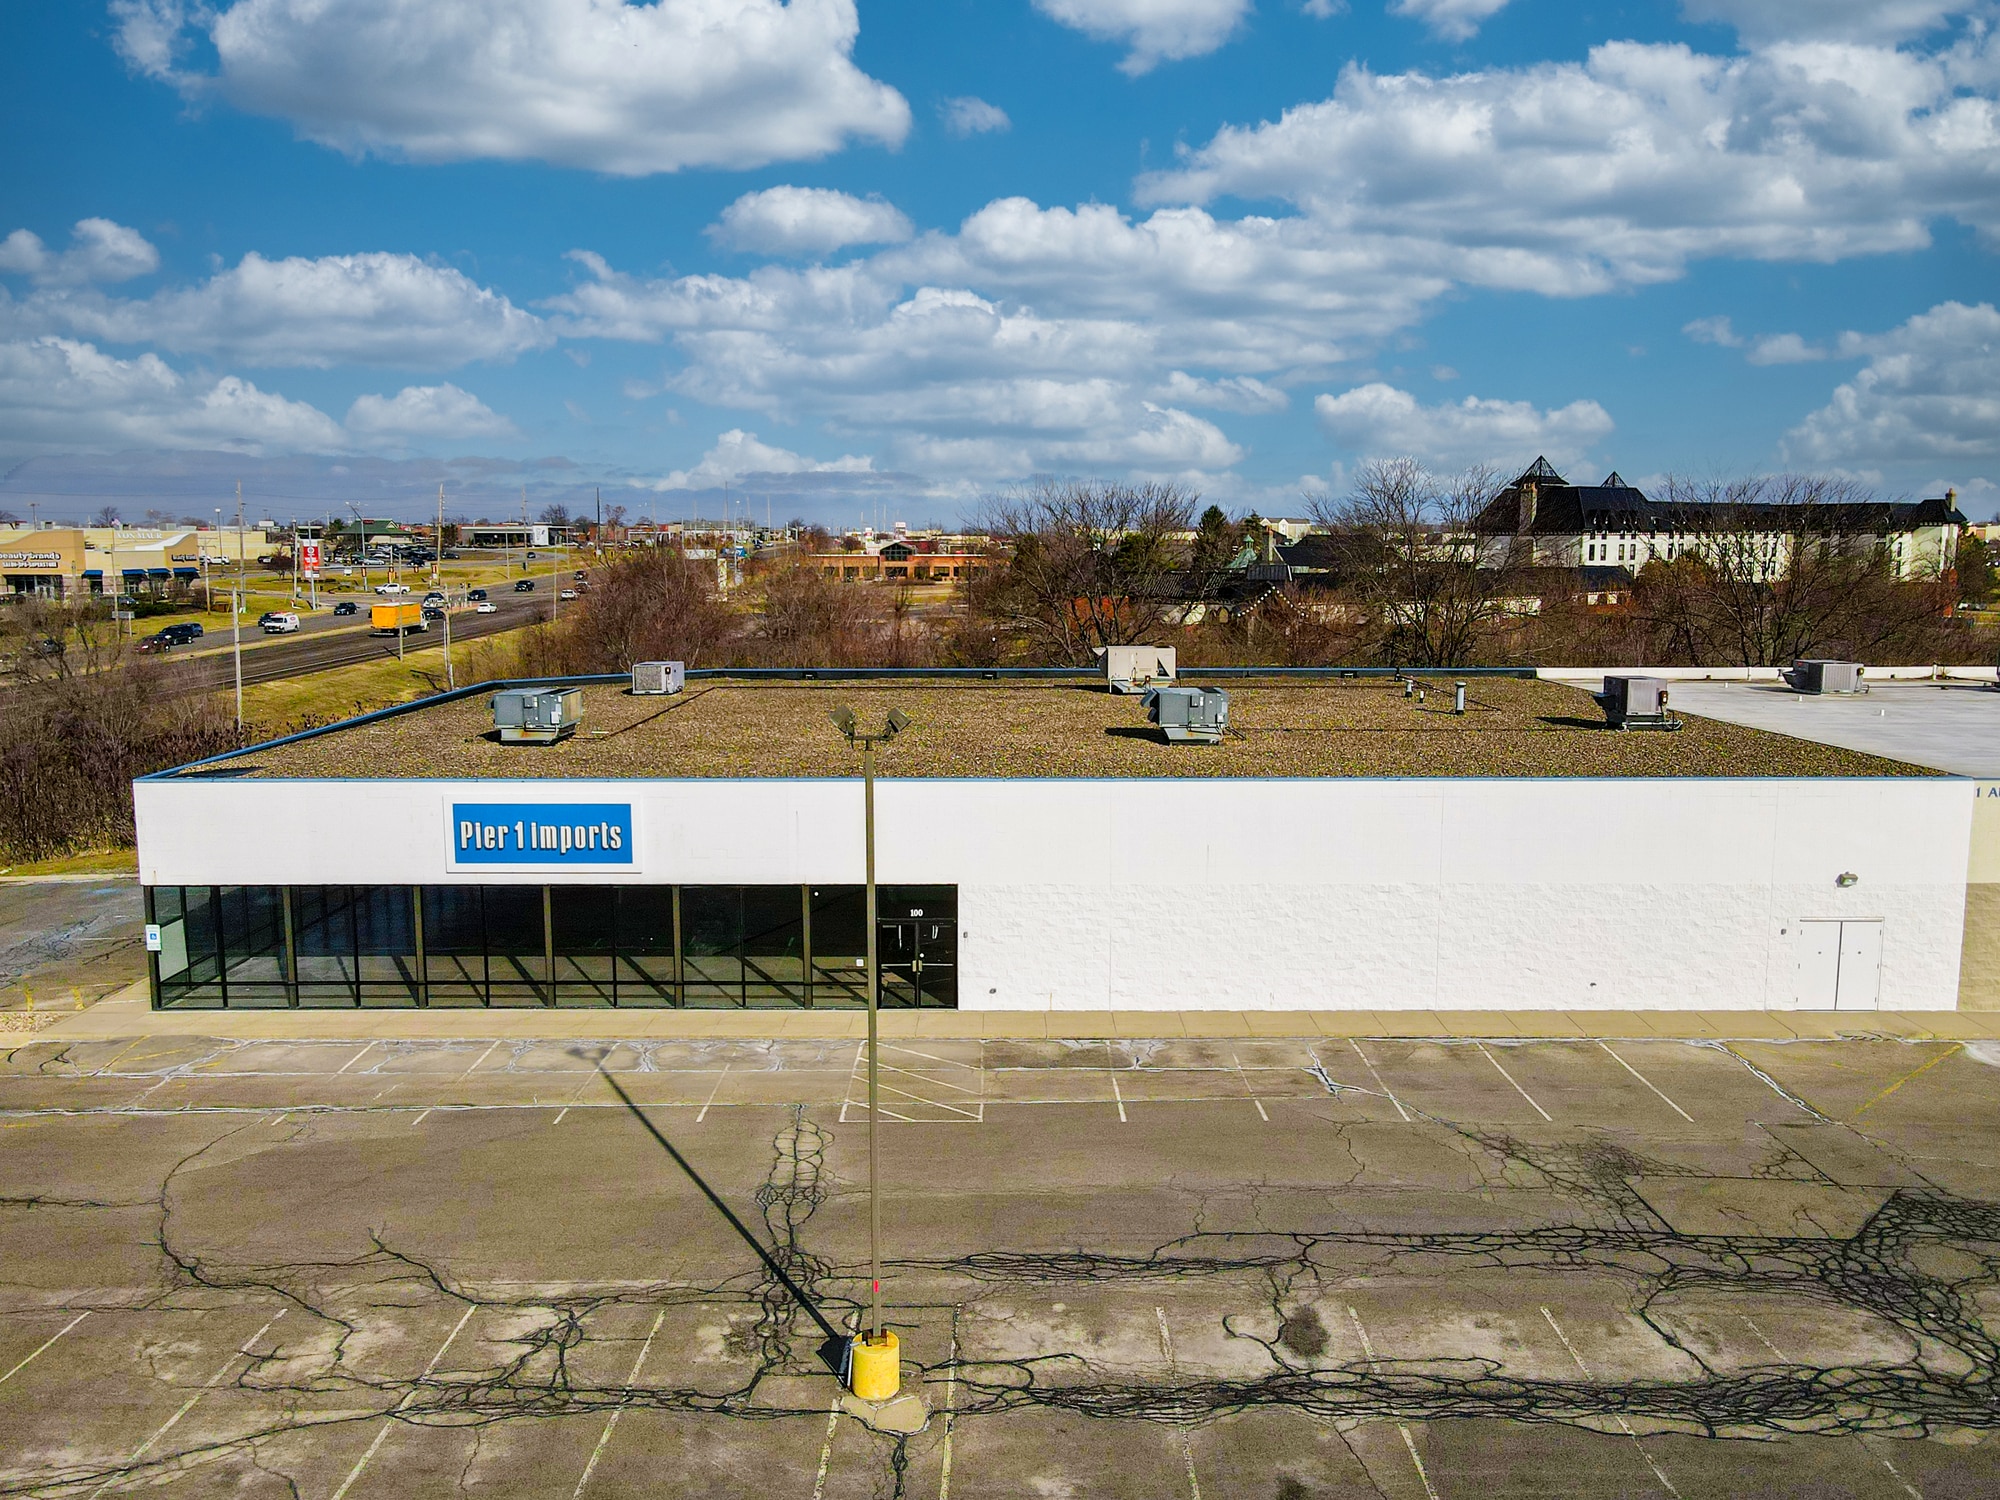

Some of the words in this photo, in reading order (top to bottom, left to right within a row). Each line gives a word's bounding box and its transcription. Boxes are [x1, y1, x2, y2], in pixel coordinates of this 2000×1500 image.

[460, 821, 509, 849] Pier
[514, 821, 524, 849] 1
[910, 909, 924, 917] 100
